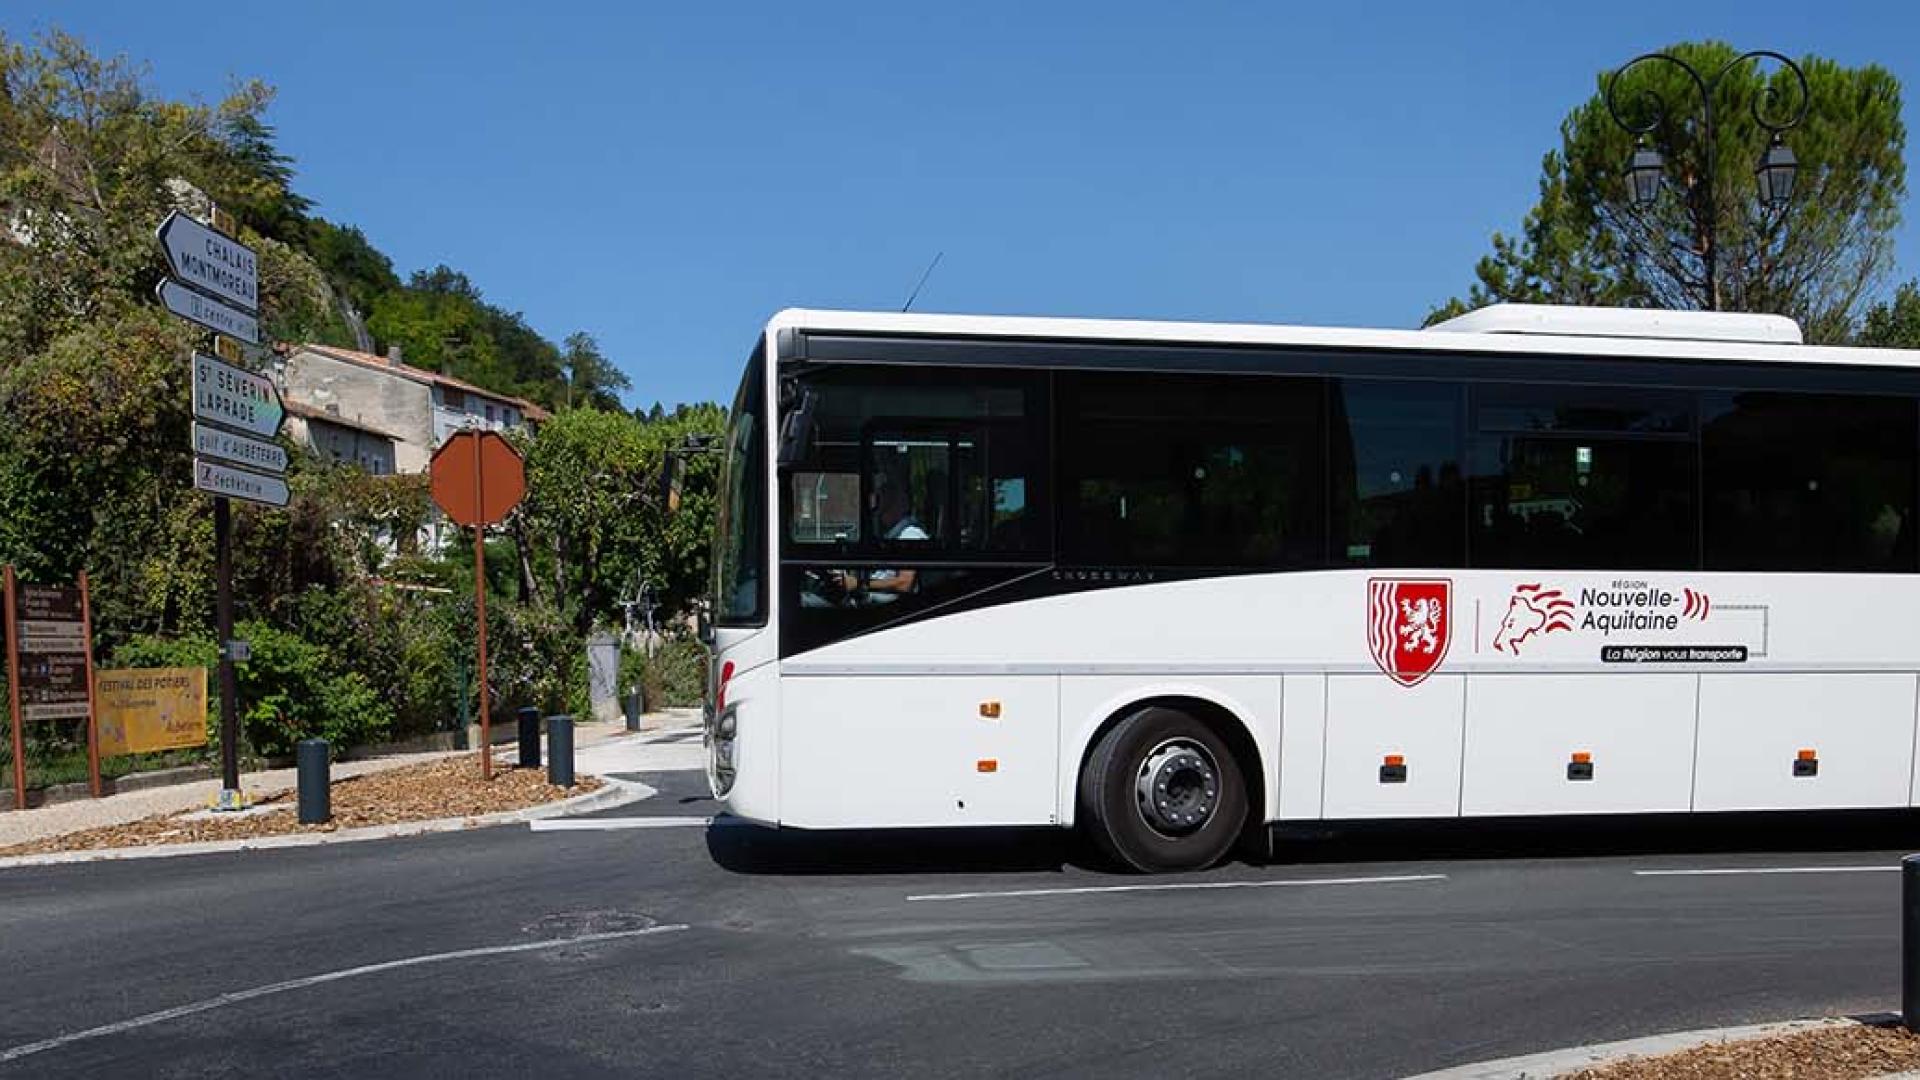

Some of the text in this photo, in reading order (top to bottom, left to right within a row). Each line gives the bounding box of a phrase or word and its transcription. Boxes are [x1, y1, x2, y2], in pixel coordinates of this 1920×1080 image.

[205, 238, 254, 276] CHALAIS
[181, 251, 255, 300] MONTMOREAU
[200, 390, 255, 424] LAPRADE
[1580, 588, 1680, 607] Nouvelle-
[1612, 580, 1648, 589] RÉGION
[1581, 610, 1679, 636] Aquitaine
[1606, 648, 1744, 663] La Région vous transporte
